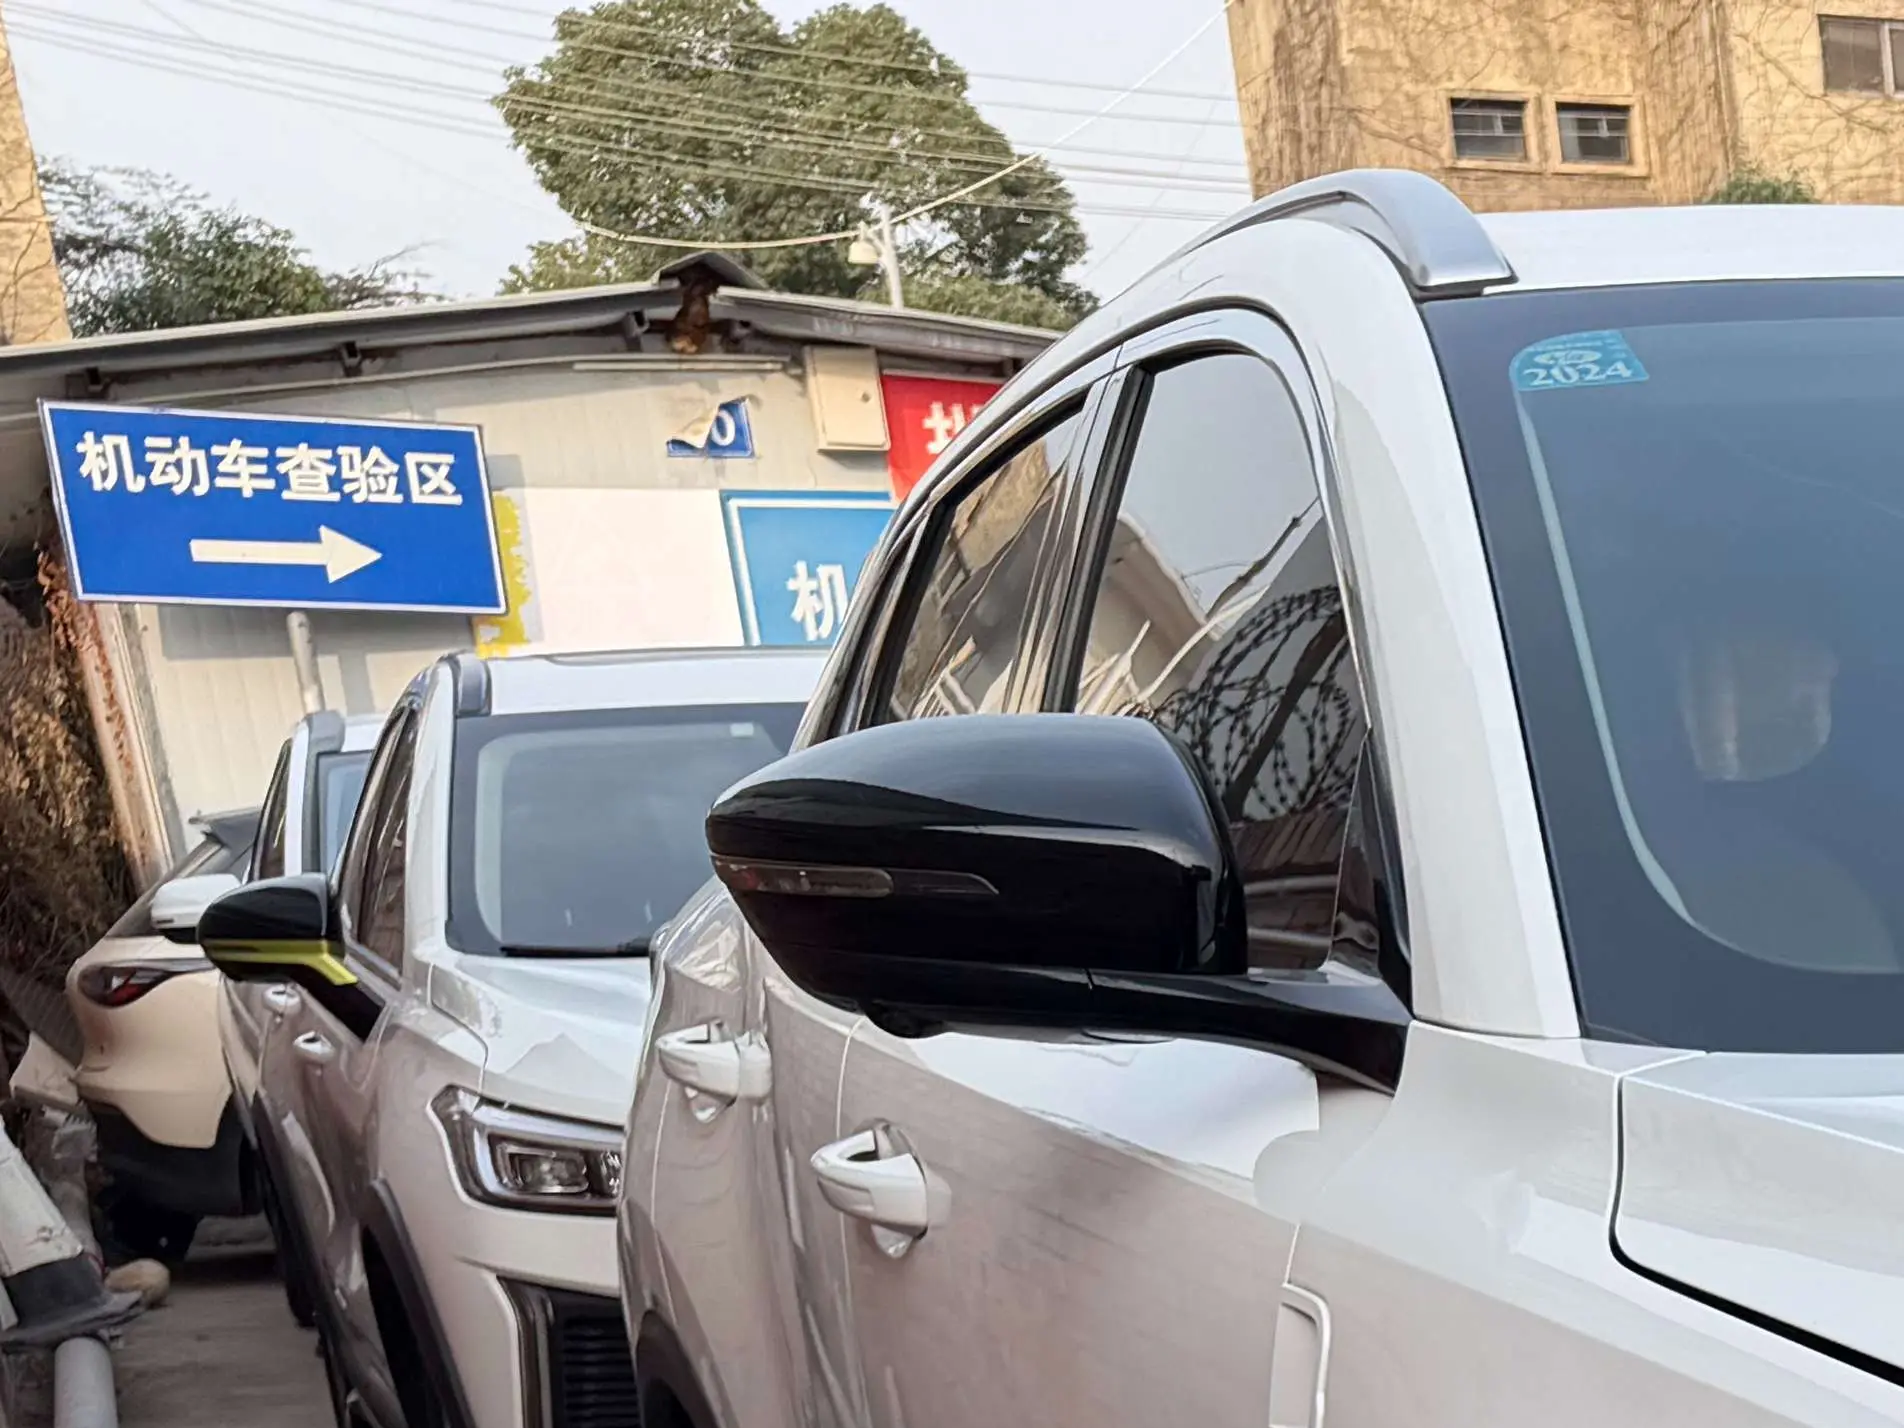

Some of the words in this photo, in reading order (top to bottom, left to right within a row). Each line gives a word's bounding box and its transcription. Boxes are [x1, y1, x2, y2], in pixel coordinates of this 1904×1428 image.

[1523, 360, 1633, 387] 2024
[75, 431, 464, 506] 机动车查验区
